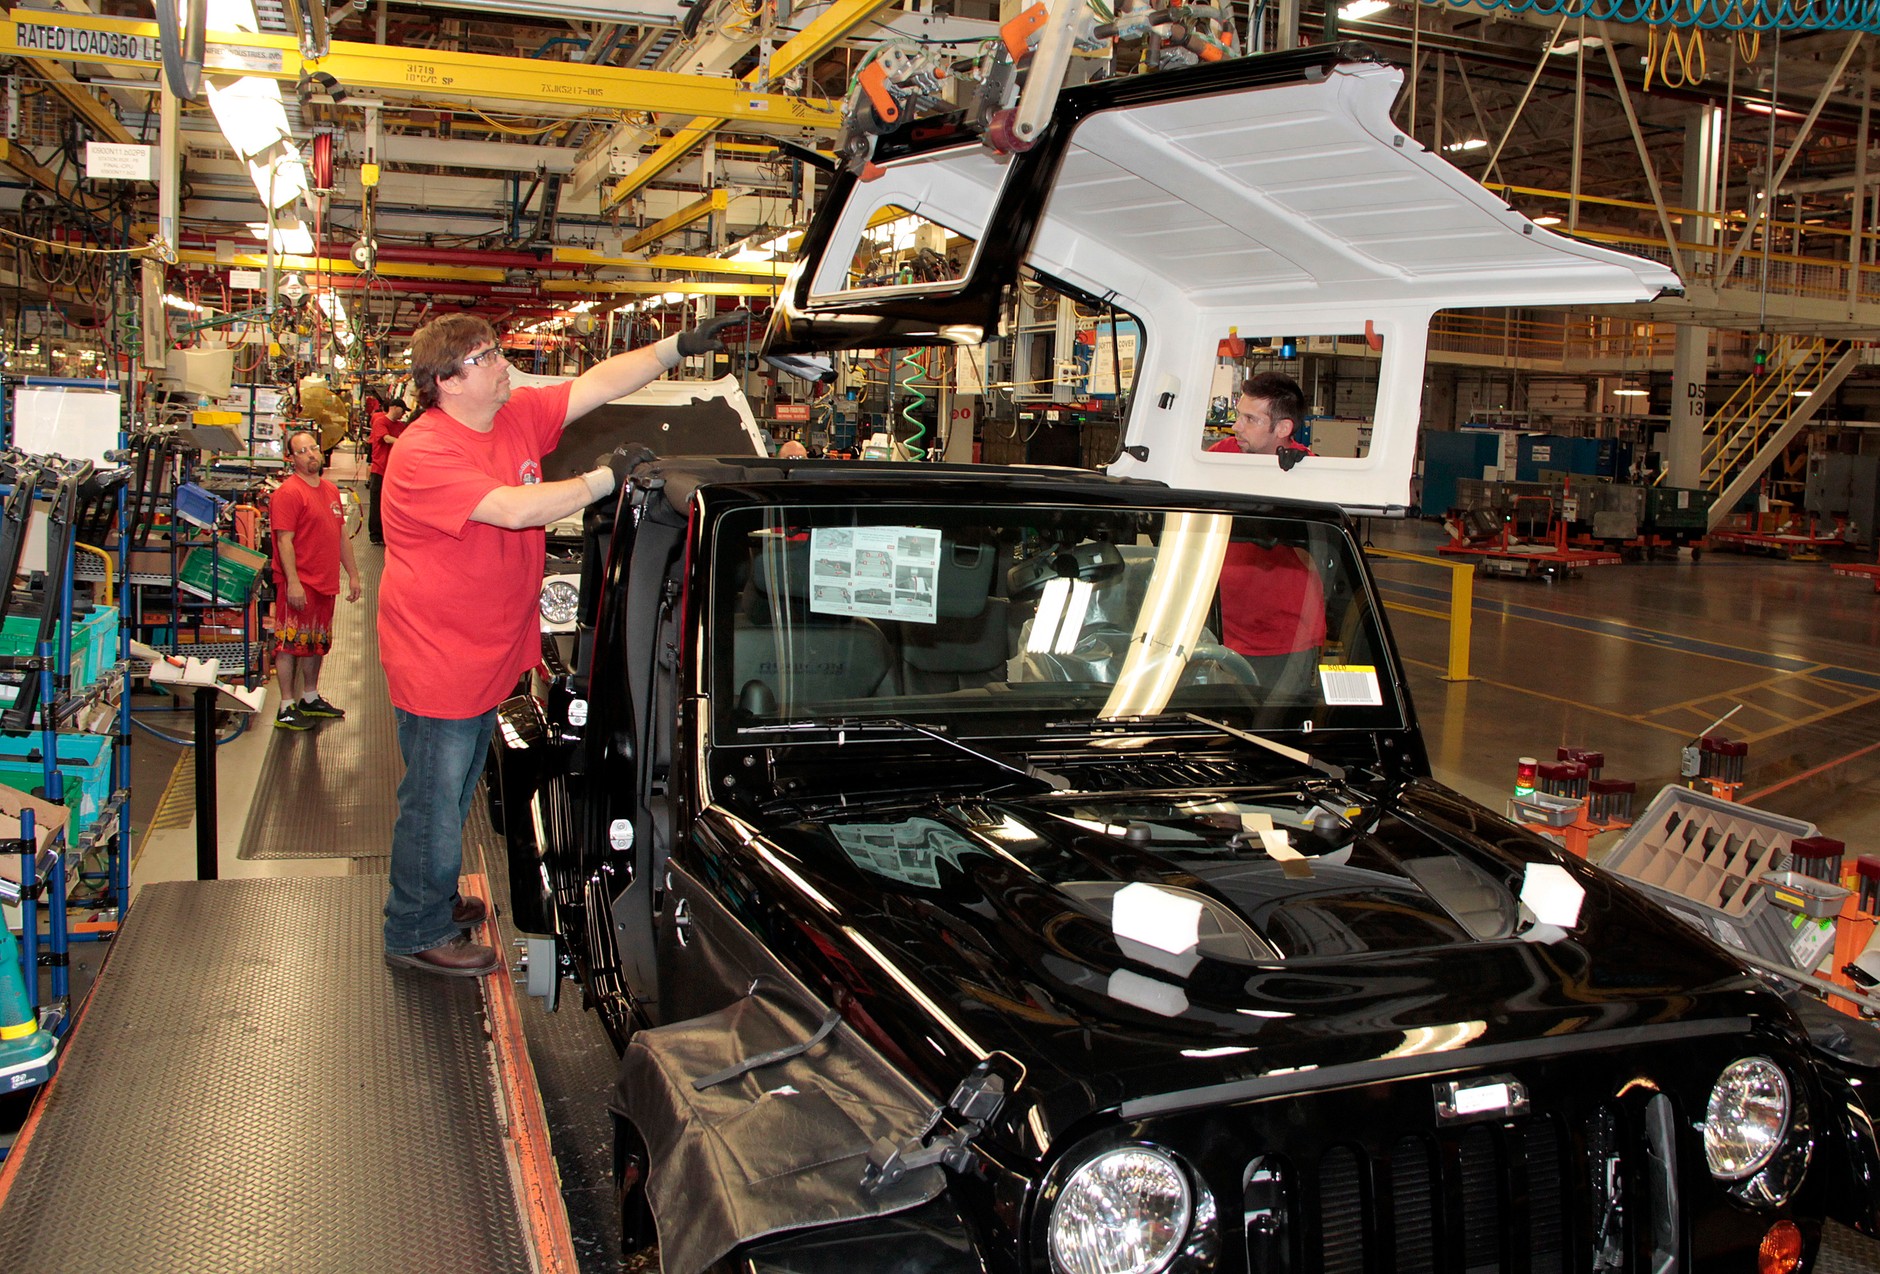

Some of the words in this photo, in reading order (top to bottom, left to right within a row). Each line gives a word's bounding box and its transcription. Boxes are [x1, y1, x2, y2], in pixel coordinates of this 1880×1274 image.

[16, 22, 66, 50] RATED
[407, 64, 435, 75] 31719
[442, 77, 454, 86] SP
[1687, 382, 1706, 399] D5
[1689, 401, 1703, 416] 13
